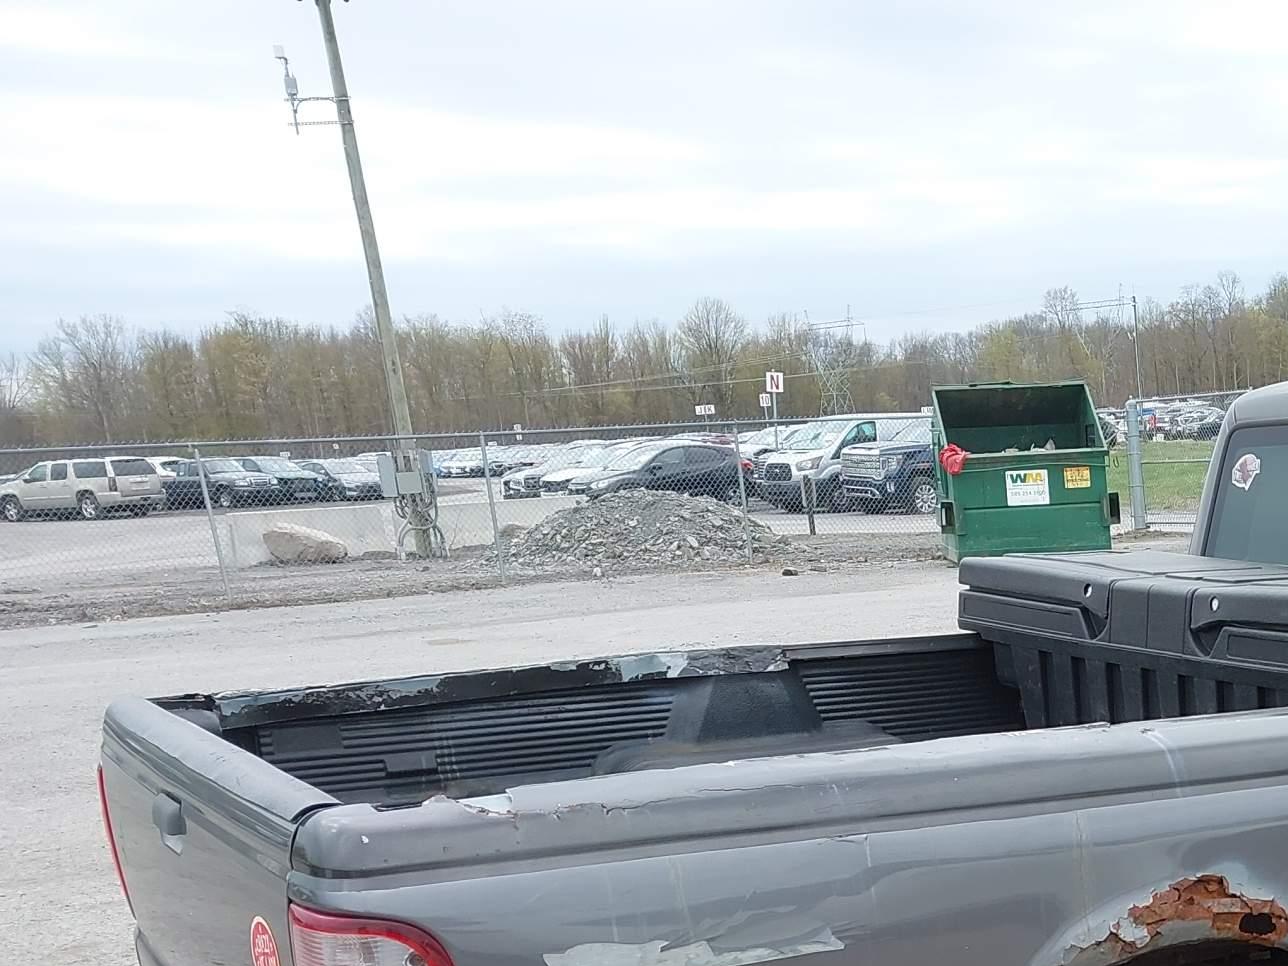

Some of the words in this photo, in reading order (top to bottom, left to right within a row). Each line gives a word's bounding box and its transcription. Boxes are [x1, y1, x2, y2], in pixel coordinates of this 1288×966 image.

[770, 375, 780, 390] N
[761, 395, 770, 406] 10
[1009, 472, 1043, 484] WM
